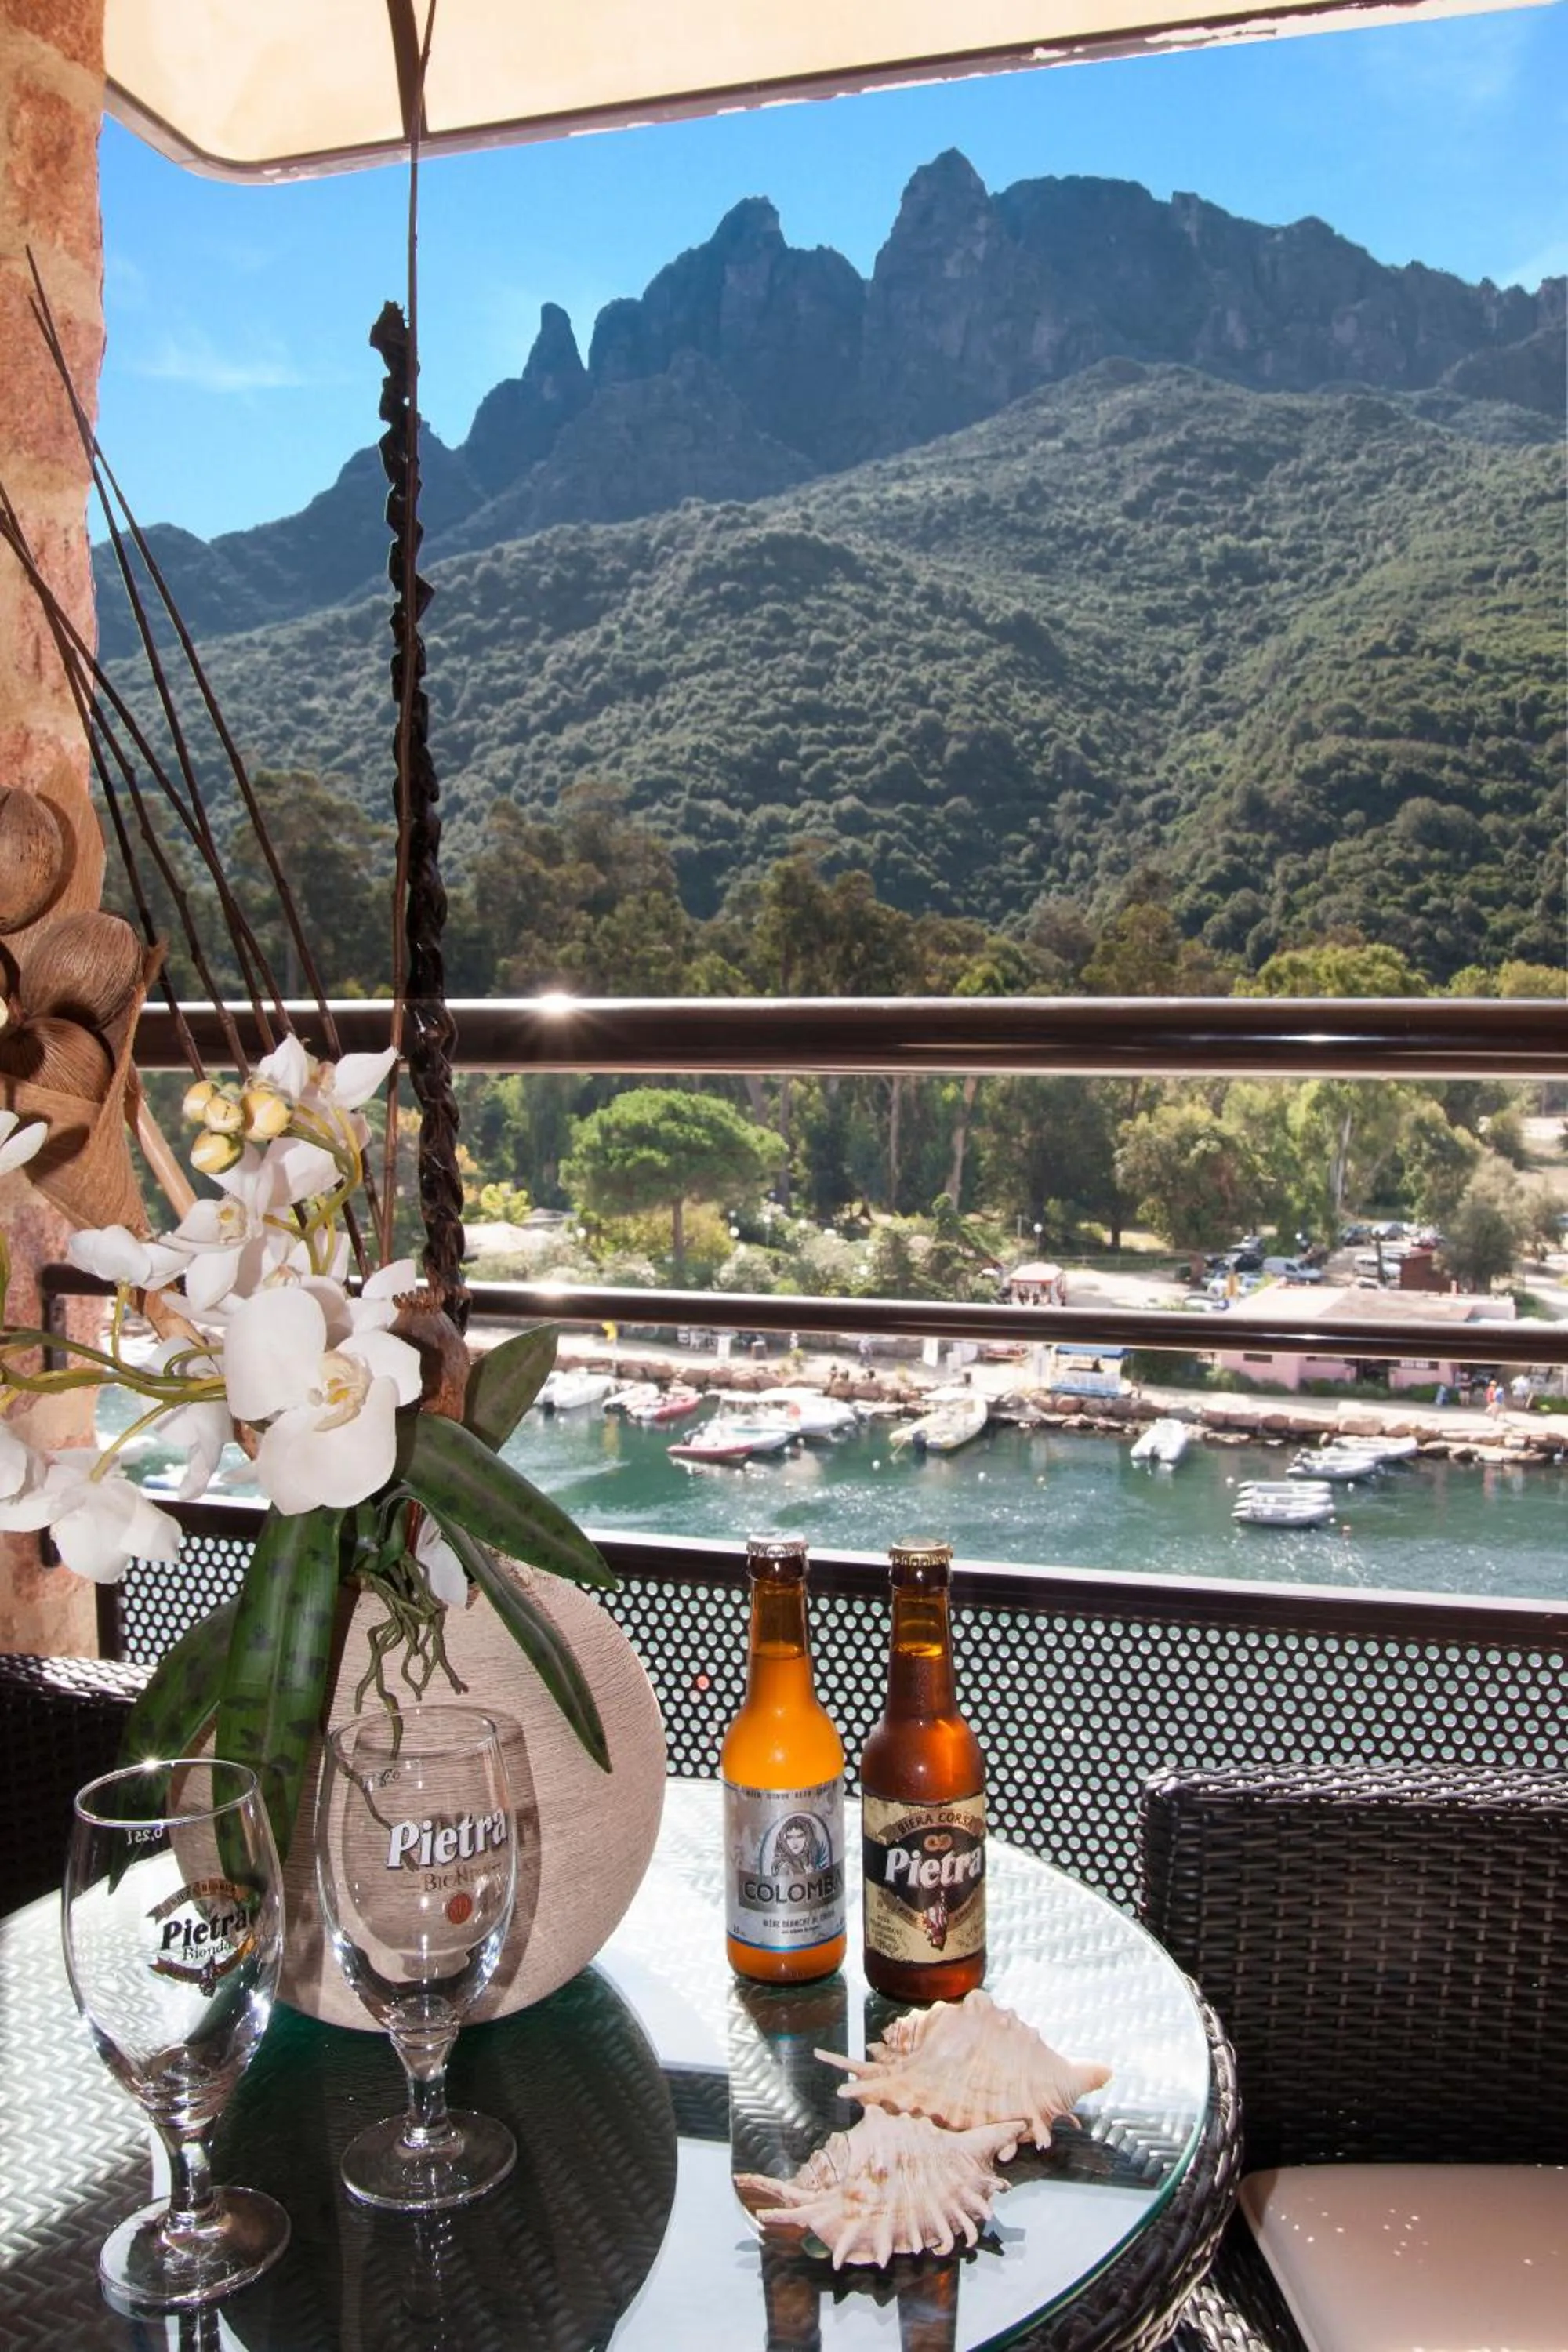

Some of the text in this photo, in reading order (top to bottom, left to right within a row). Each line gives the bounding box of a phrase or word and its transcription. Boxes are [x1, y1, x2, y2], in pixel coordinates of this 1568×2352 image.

[386, 1807, 509, 1869] Pietra
[884, 1846, 982, 1889] Pietra
[161, 1908, 247, 1950] Pietra
